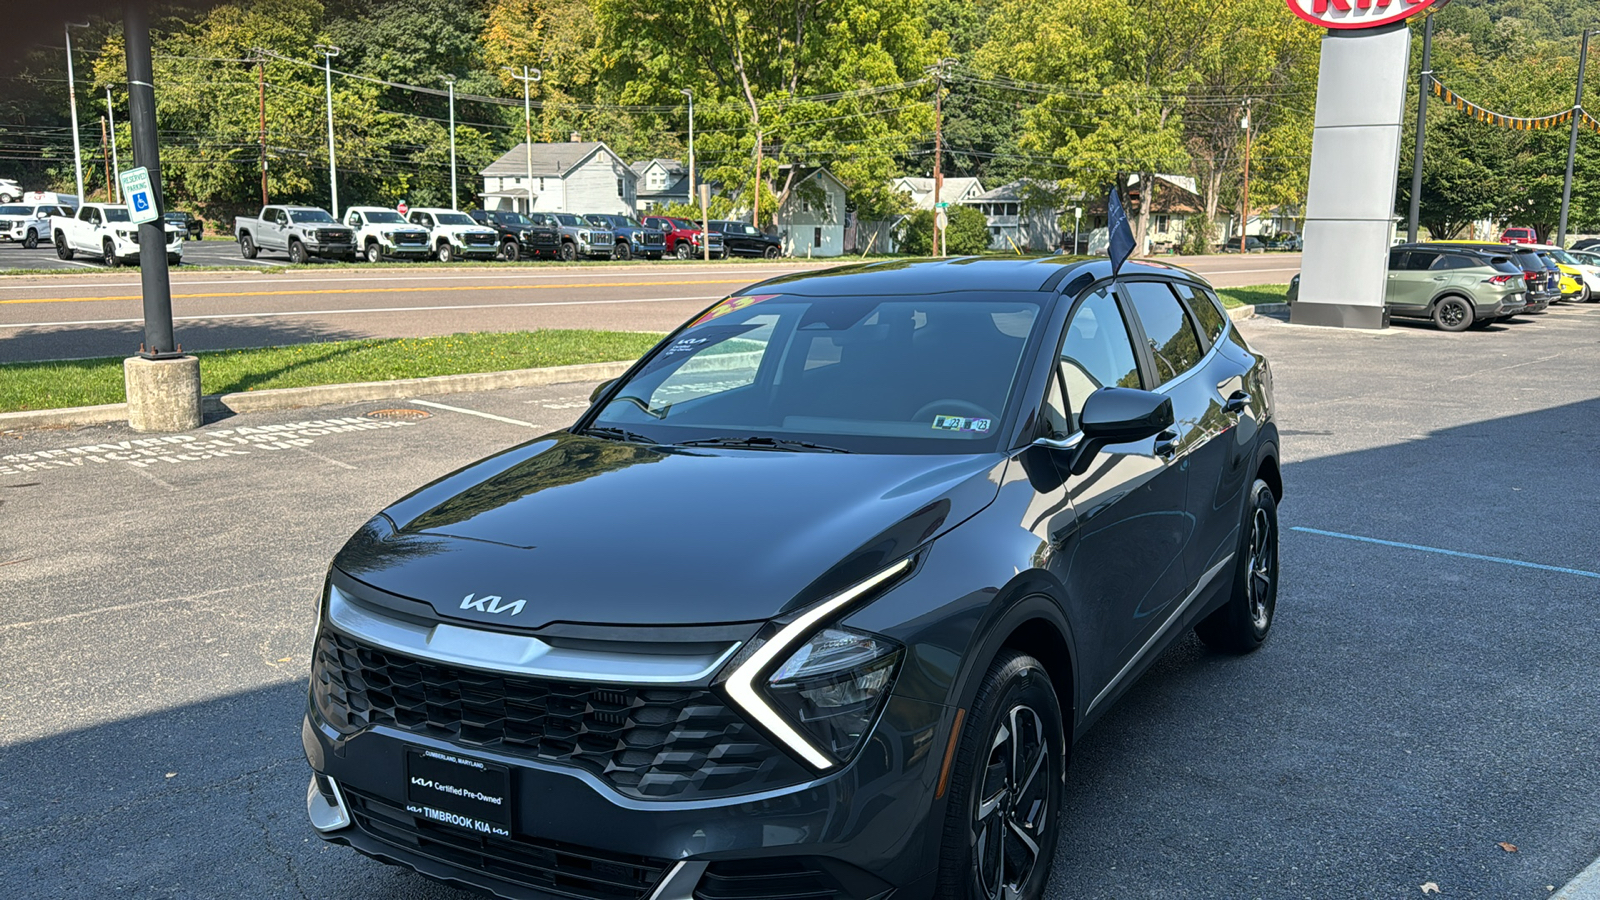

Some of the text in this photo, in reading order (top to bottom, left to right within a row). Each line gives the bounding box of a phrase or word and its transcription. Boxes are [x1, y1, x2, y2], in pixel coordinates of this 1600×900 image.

[122, 173, 147, 184] RESERVED
[127, 182, 147, 192] PARKING
[459, 592, 527, 616] KIA
[425, 750, 484, 769] CUMBERLAND, MARYLAND
[434, 782, 462, 796] Certified
[463, 789, 502, 805] Pre-Owned
[423, 807, 473, 829] TIMBROOK
[474, 820, 491, 834] KIA
